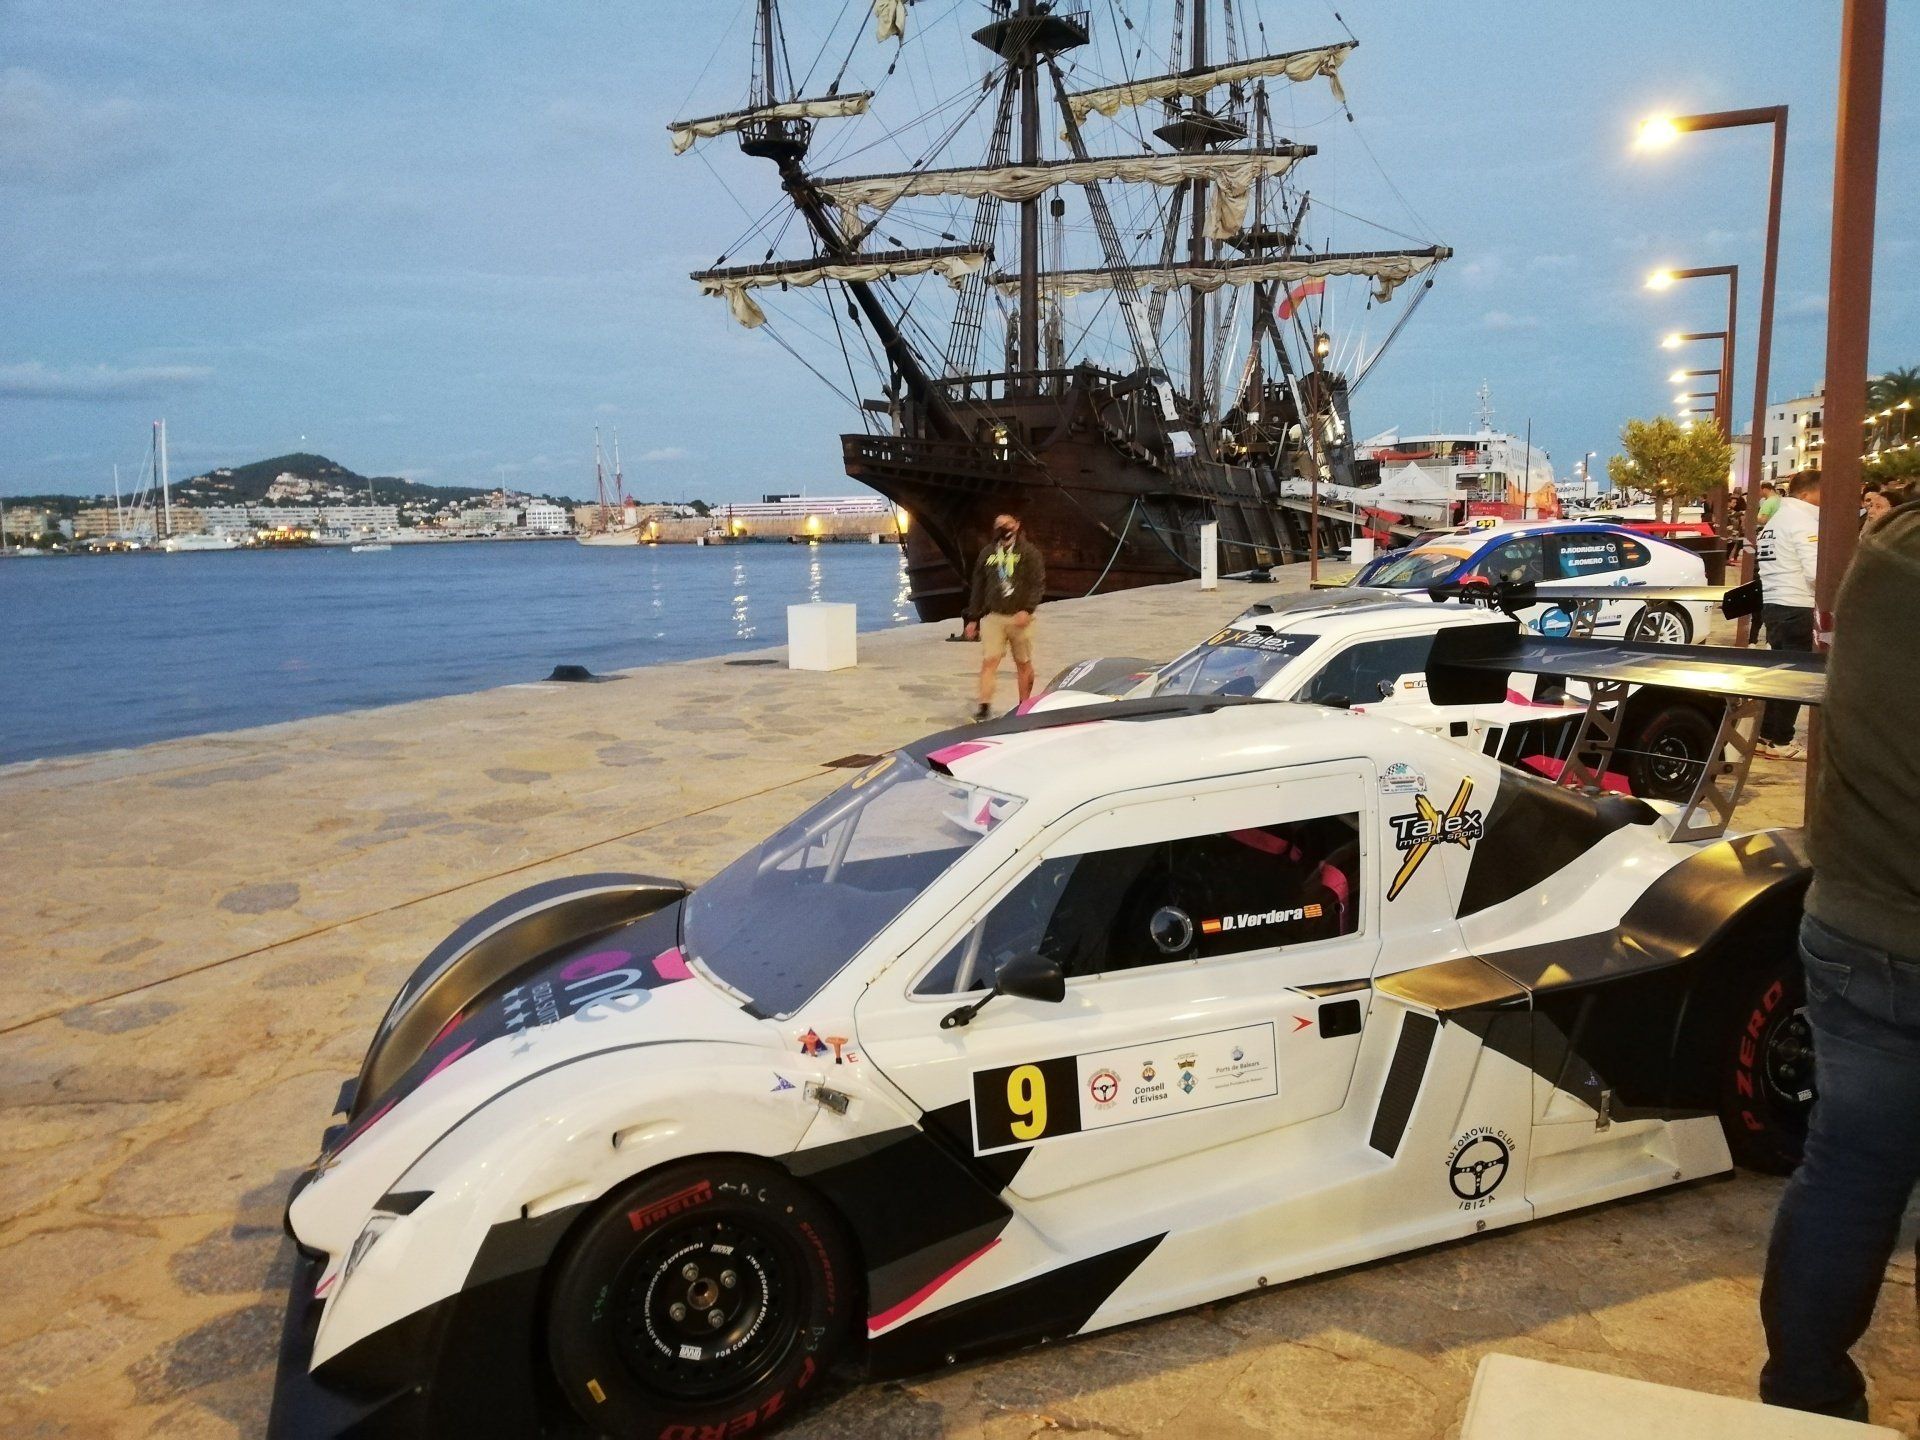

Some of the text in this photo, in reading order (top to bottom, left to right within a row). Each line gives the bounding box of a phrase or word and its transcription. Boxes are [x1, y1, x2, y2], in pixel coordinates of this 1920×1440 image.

[1561, 545, 1605, 554] D.RODRIGUEZ
[1241, 633, 1295, 649] Talex
[1393, 813, 1480, 839] Talex
[1399, 828, 1480, 847] motor sport
[1222, 907, 1303, 931] D.Verdera
[846, 1052, 859, 1063] E
[1132, 1091, 1168, 1105] d'Eivissa
[1134, 1083, 1166, 1096] Consell
[1006, 1064, 1048, 1141] 9
[1445, 1126, 1515, 1167] AUTOMOVIL CLUB
[628, 1180, 713, 1231] PIRELLI
[1459, 1195, 1495, 1210] IBIZA
[715, 1348, 731, 1359] FOR
[732, 1306, 767, 1351] COMPETITION
